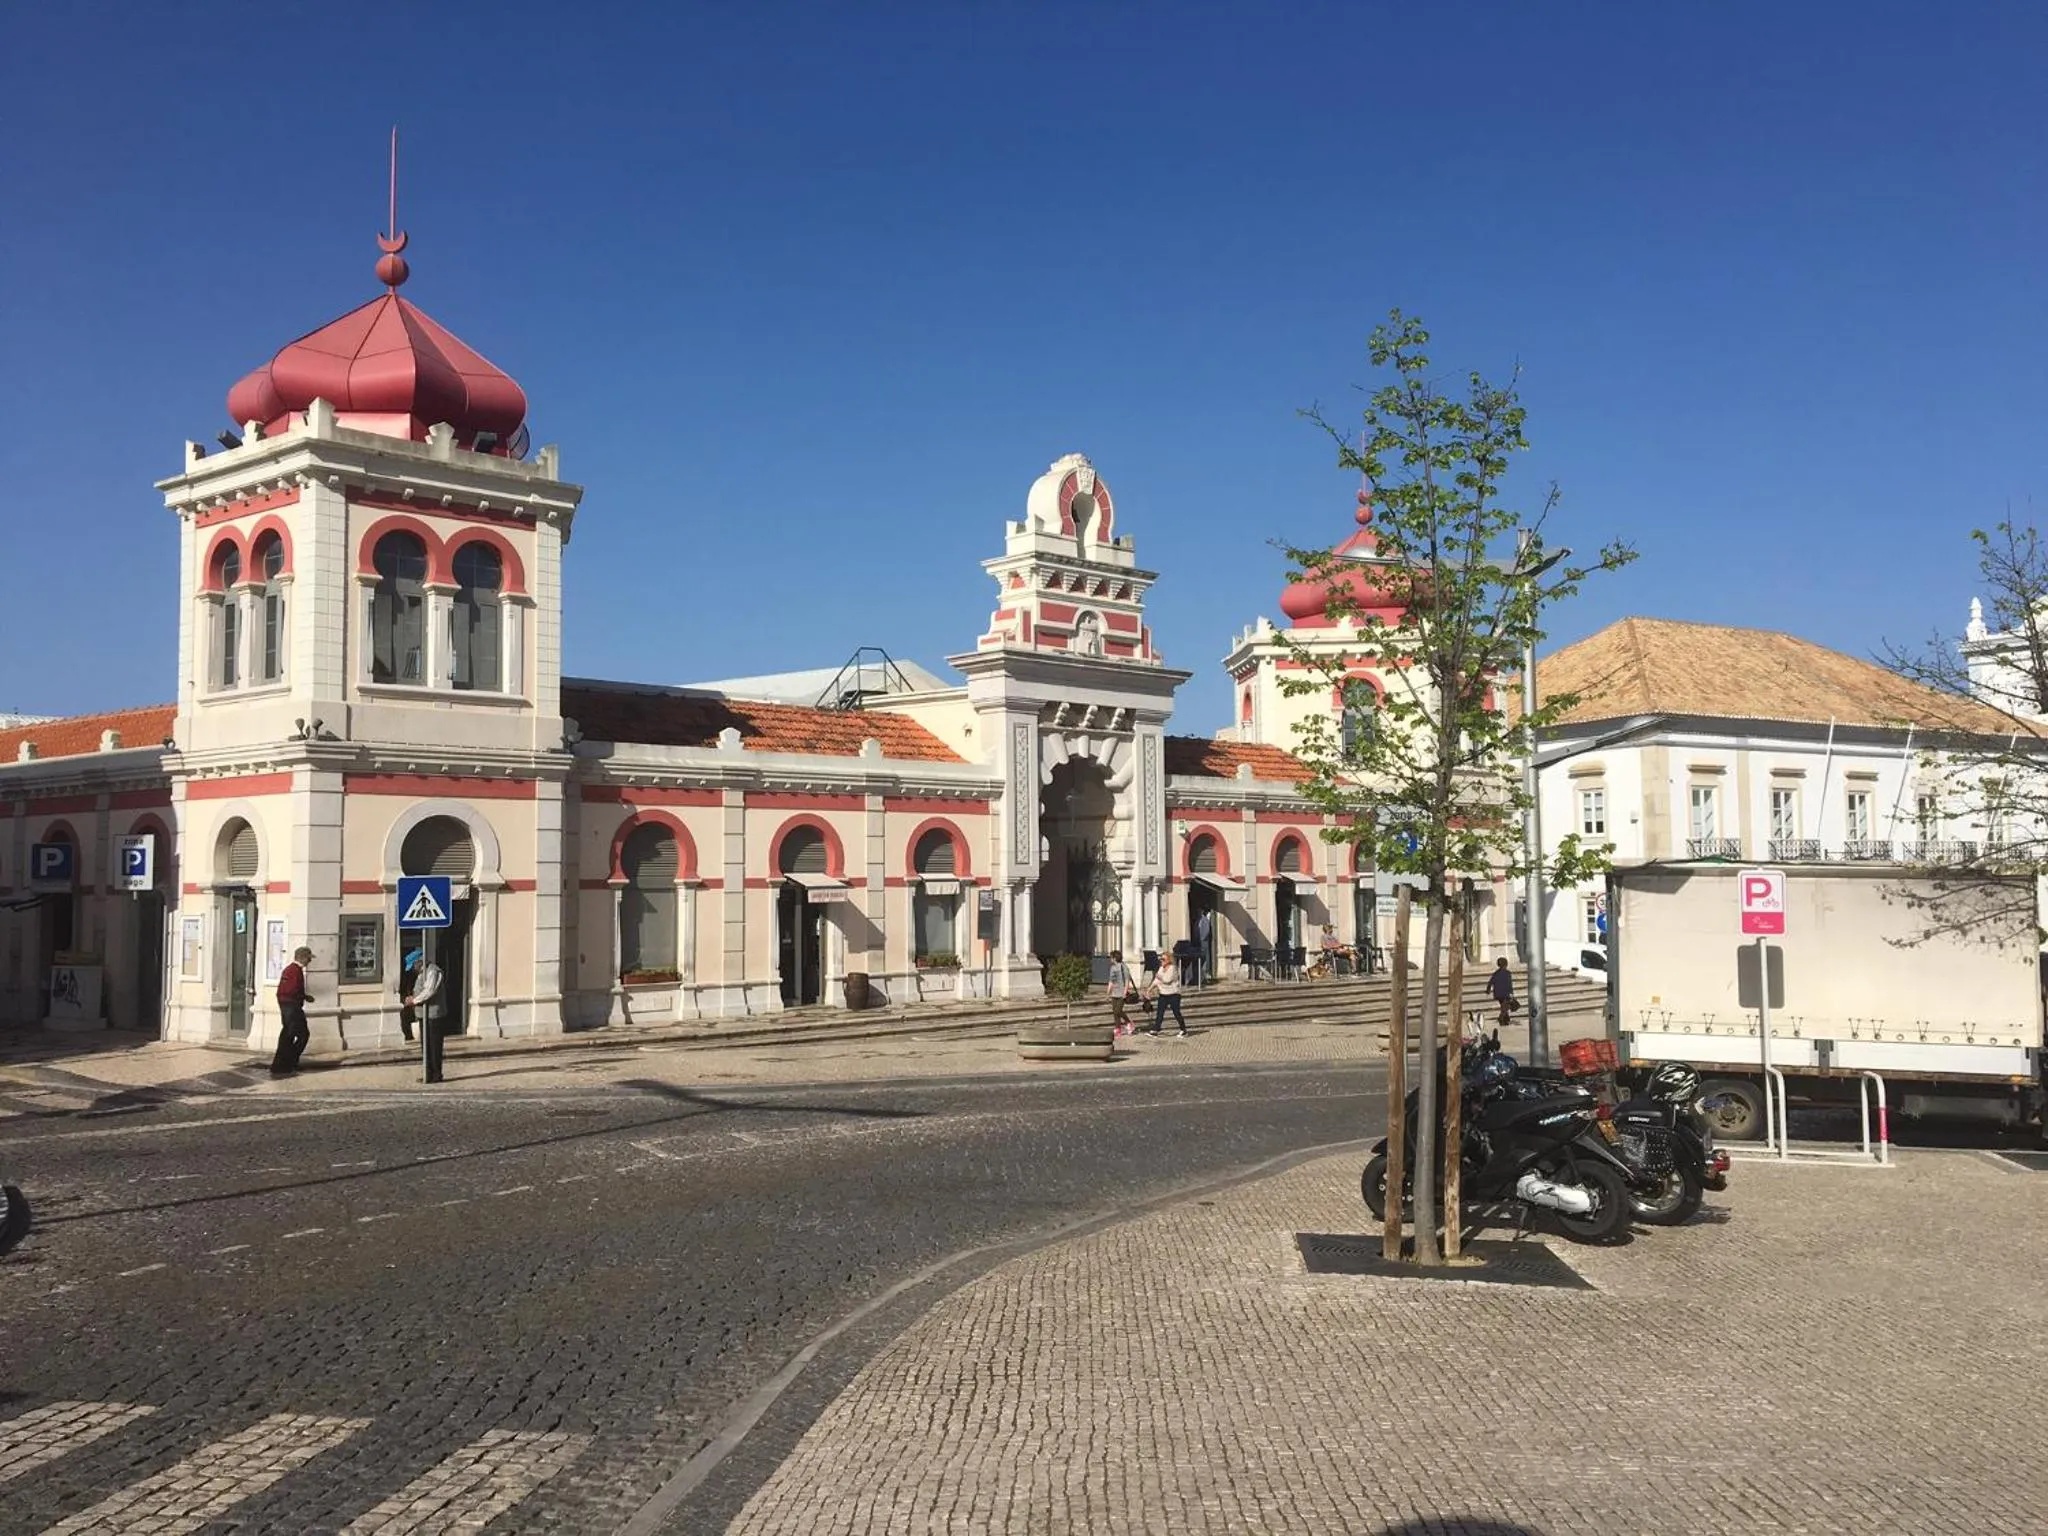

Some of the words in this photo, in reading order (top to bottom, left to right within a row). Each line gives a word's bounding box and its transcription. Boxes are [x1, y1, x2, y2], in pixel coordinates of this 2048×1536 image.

[41, 847, 65, 876] P
[126, 850, 142, 874] P
[1746, 877, 1772, 907] P
